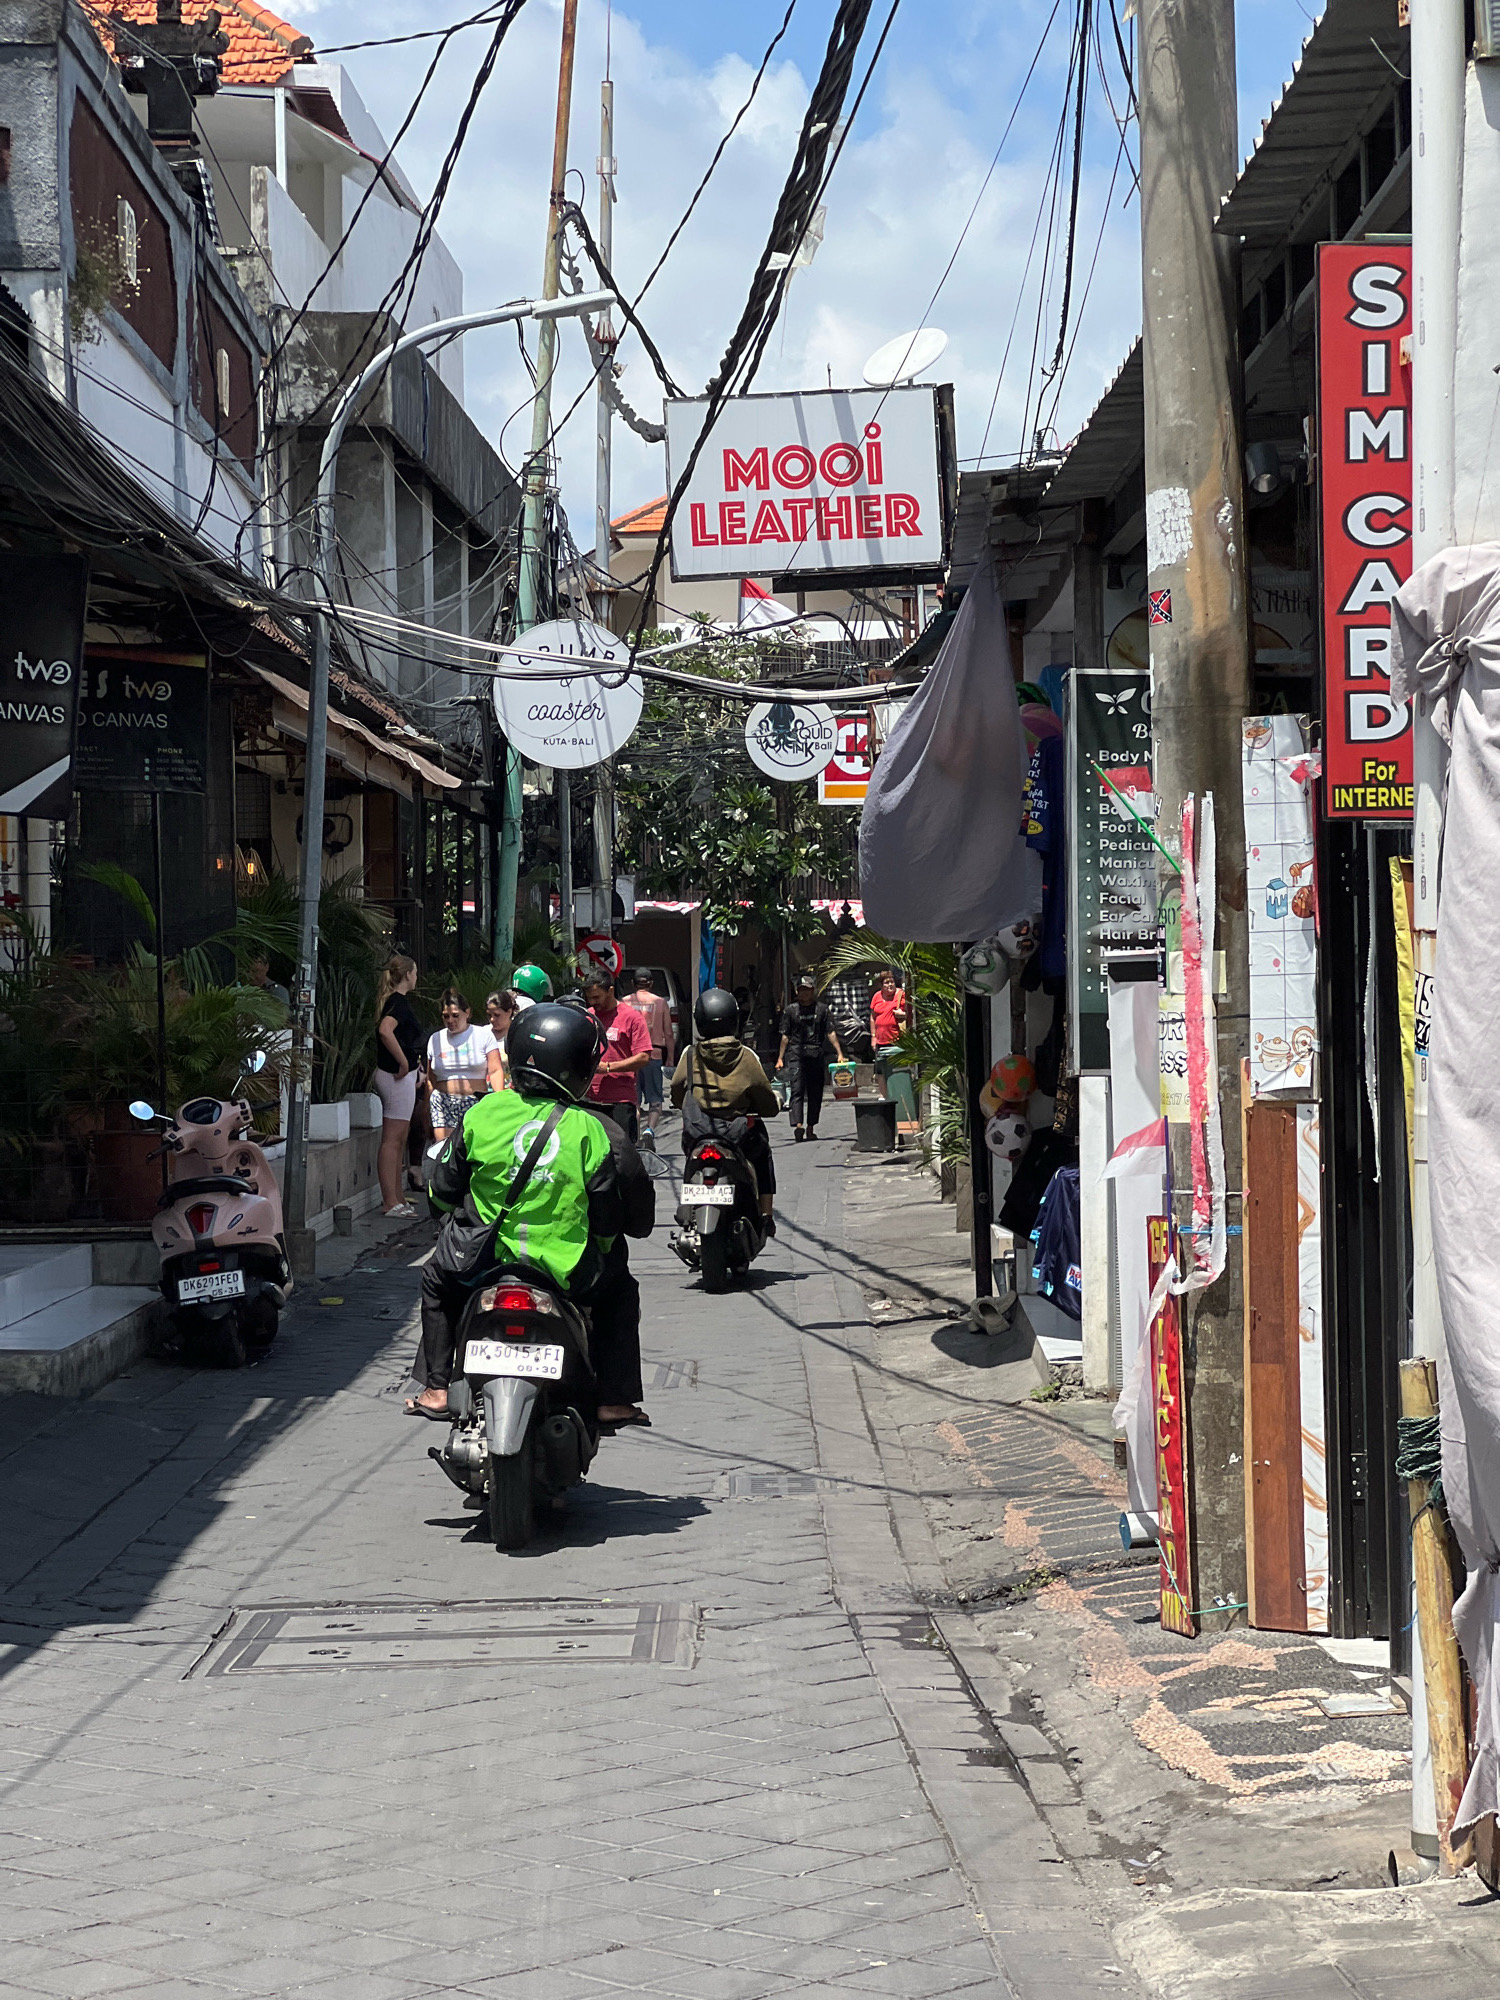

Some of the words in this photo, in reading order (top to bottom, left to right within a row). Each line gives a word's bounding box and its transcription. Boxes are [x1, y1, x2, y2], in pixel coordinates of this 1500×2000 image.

[1344, 261, 1408, 463] SIM
[690, 493, 923, 547] LEATHER
[1337, 491, 1412, 744] CARD
[527, 700, 605, 721] coaster
[92, 711, 168, 729] CANVAS
[814, 741, 833, 750] Bali
[1099, 750, 1139, 765] Body
[1364, 760, 1397, 782] For
[1099, 821, 1136, 834] Foot
[1099, 892, 1146, 905] Facial
[1099, 910, 1126, 923] Ear
[1099, 928, 1134, 940] Hair
[470, 1344, 489, 1357] DK
